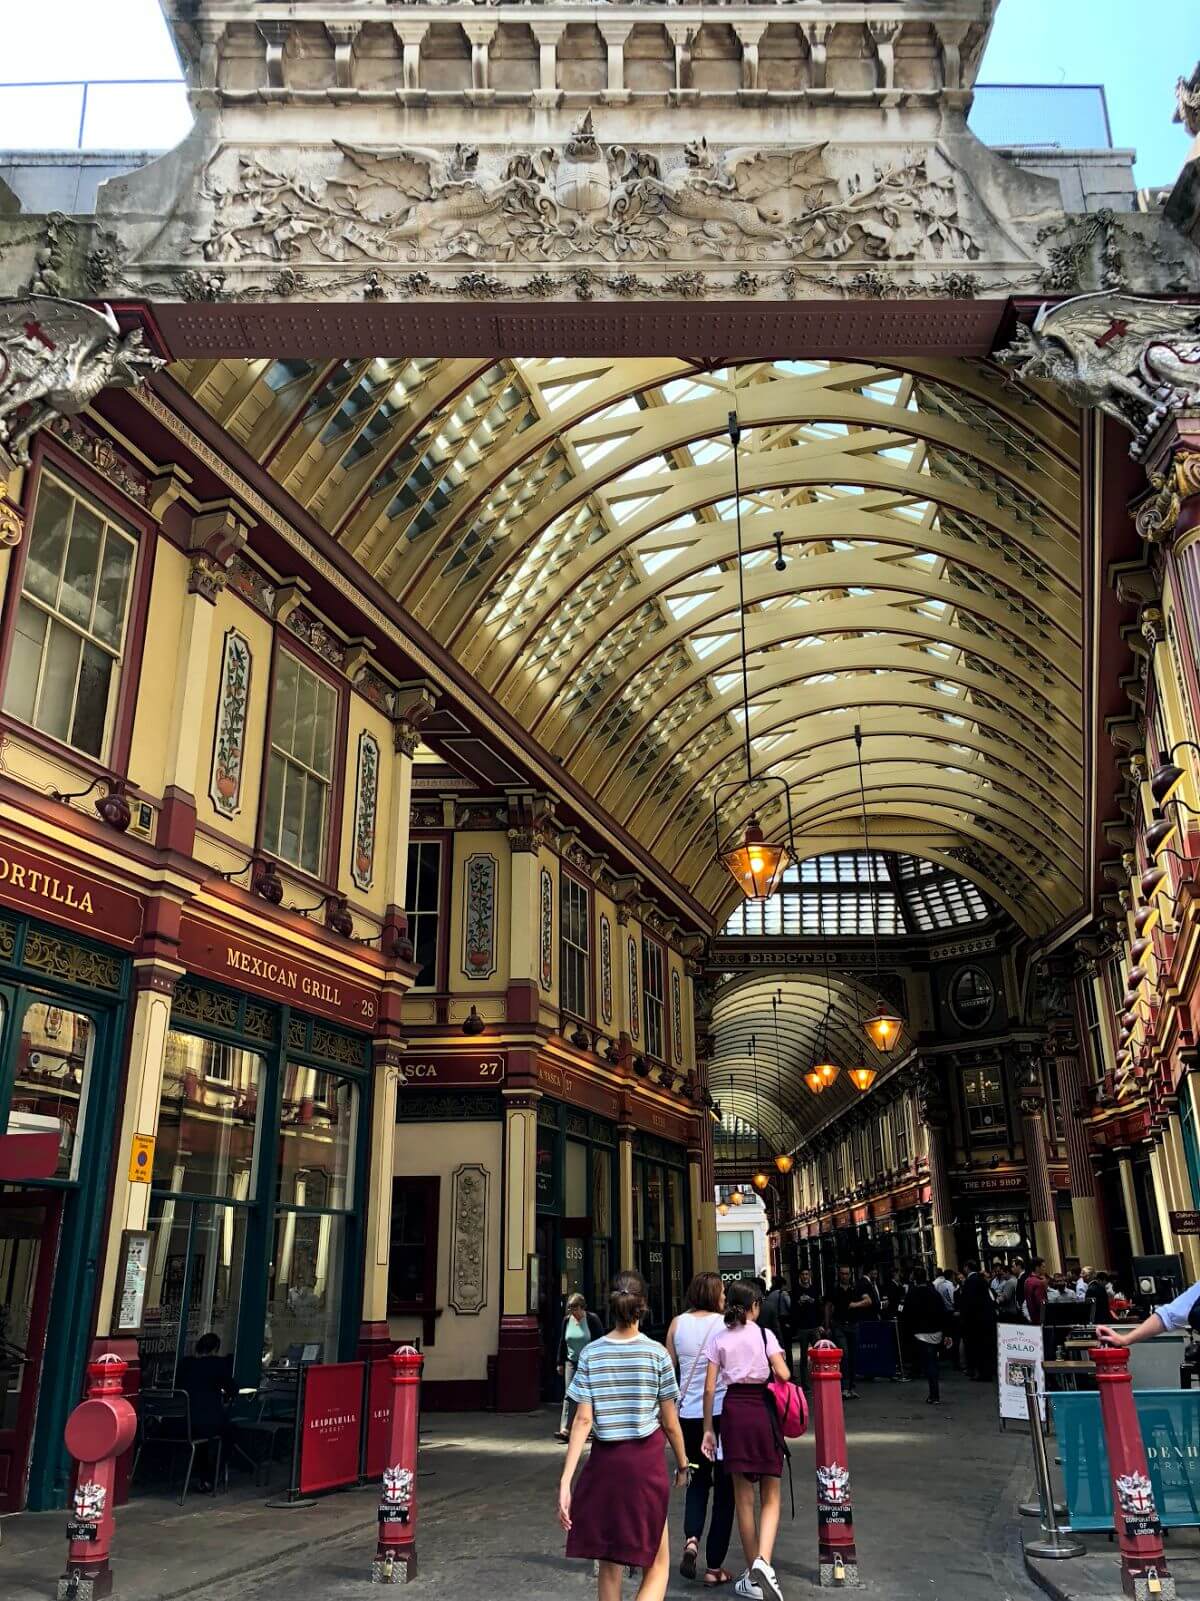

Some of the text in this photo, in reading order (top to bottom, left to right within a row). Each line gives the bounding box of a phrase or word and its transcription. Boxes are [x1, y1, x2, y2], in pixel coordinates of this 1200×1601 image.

[750, 952, 837, 963] ERECTED
[226, 948, 374, 1018] MEXICAN GRILL 28
[479, 1062, 499, 1076] 27
[964, 1178, 1022, 1190] THE PEN SHOP
[1006, 1343, 1035, 1353] SALAD
